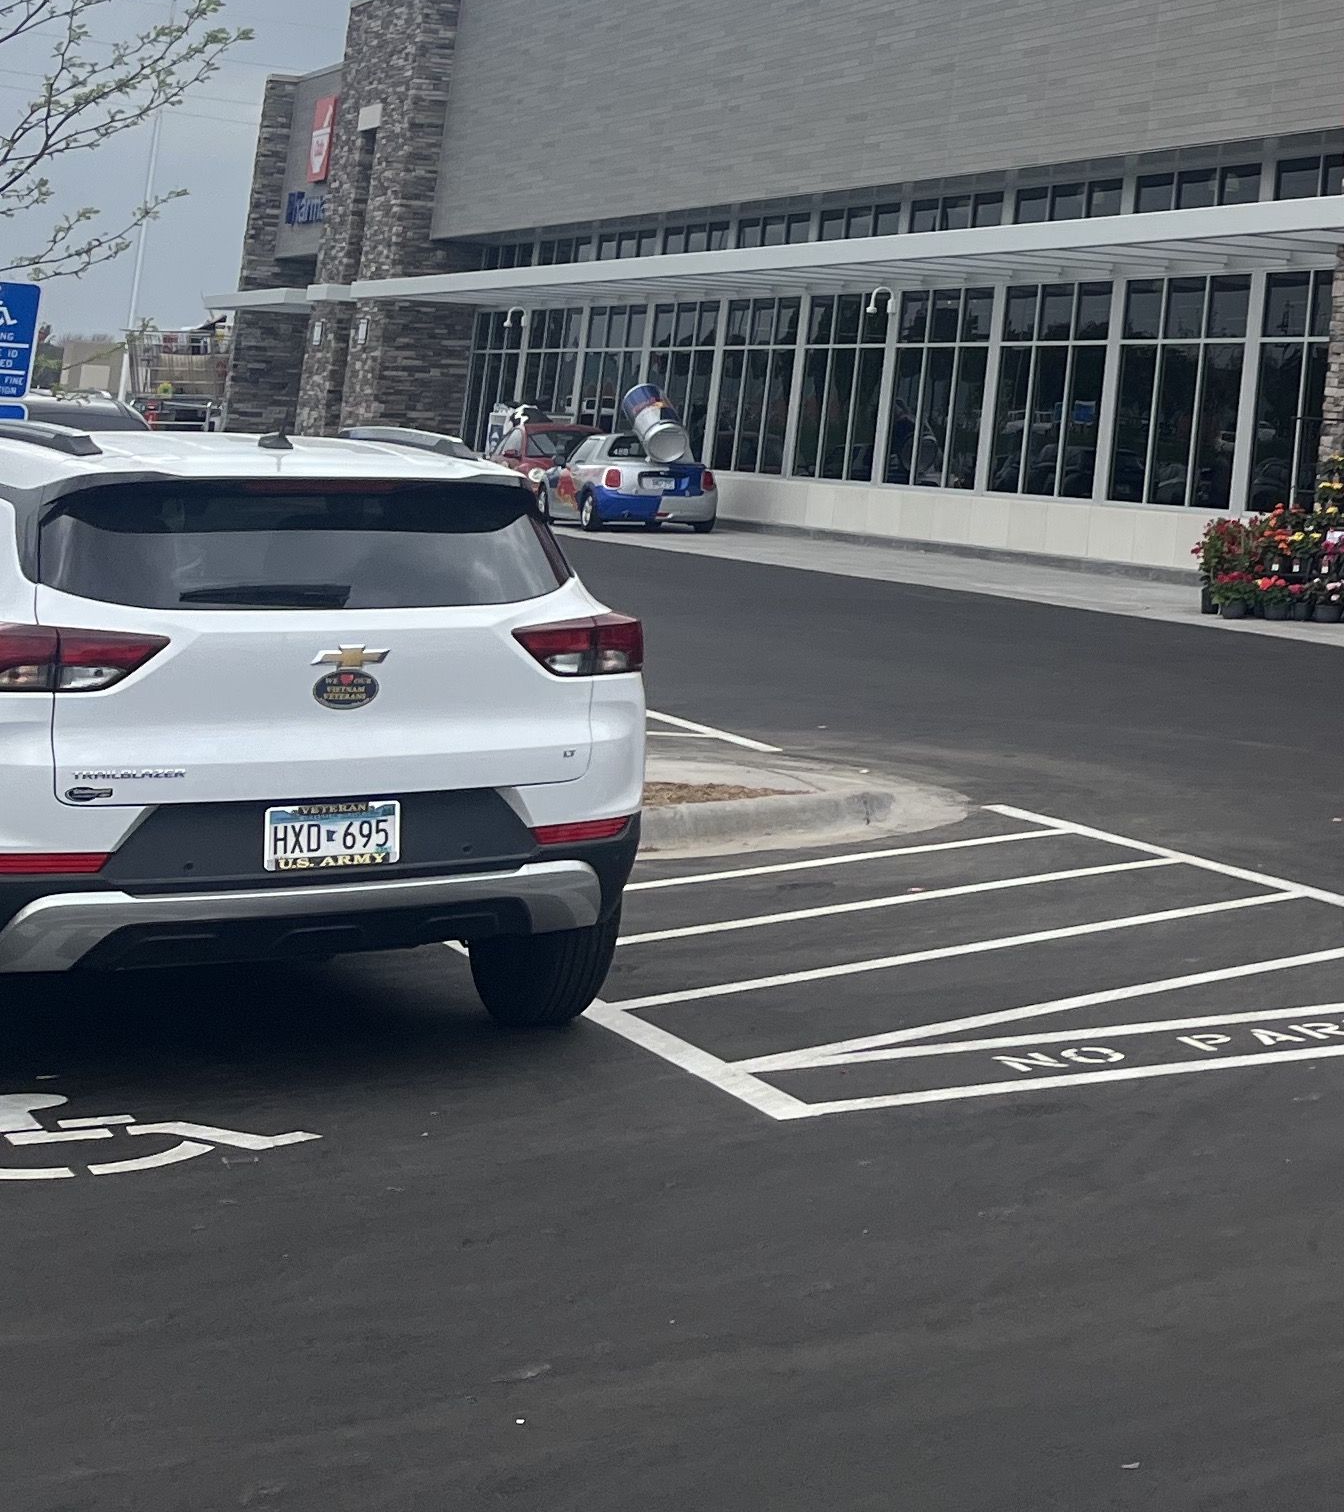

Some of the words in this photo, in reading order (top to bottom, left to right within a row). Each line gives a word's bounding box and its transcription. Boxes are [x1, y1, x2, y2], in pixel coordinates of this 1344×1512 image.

[72, 768, 187, 780] TRAILBLAZER
[301, 803, 367, 815] VETERAN
[273, 823, 321, 855] HXD
[342, 819, 389, 850] 695
[278, 857, 315, 869] U.S.
[319, 852, 386, 867] ARMY
[992, 1045, 1126, 1073] NO
